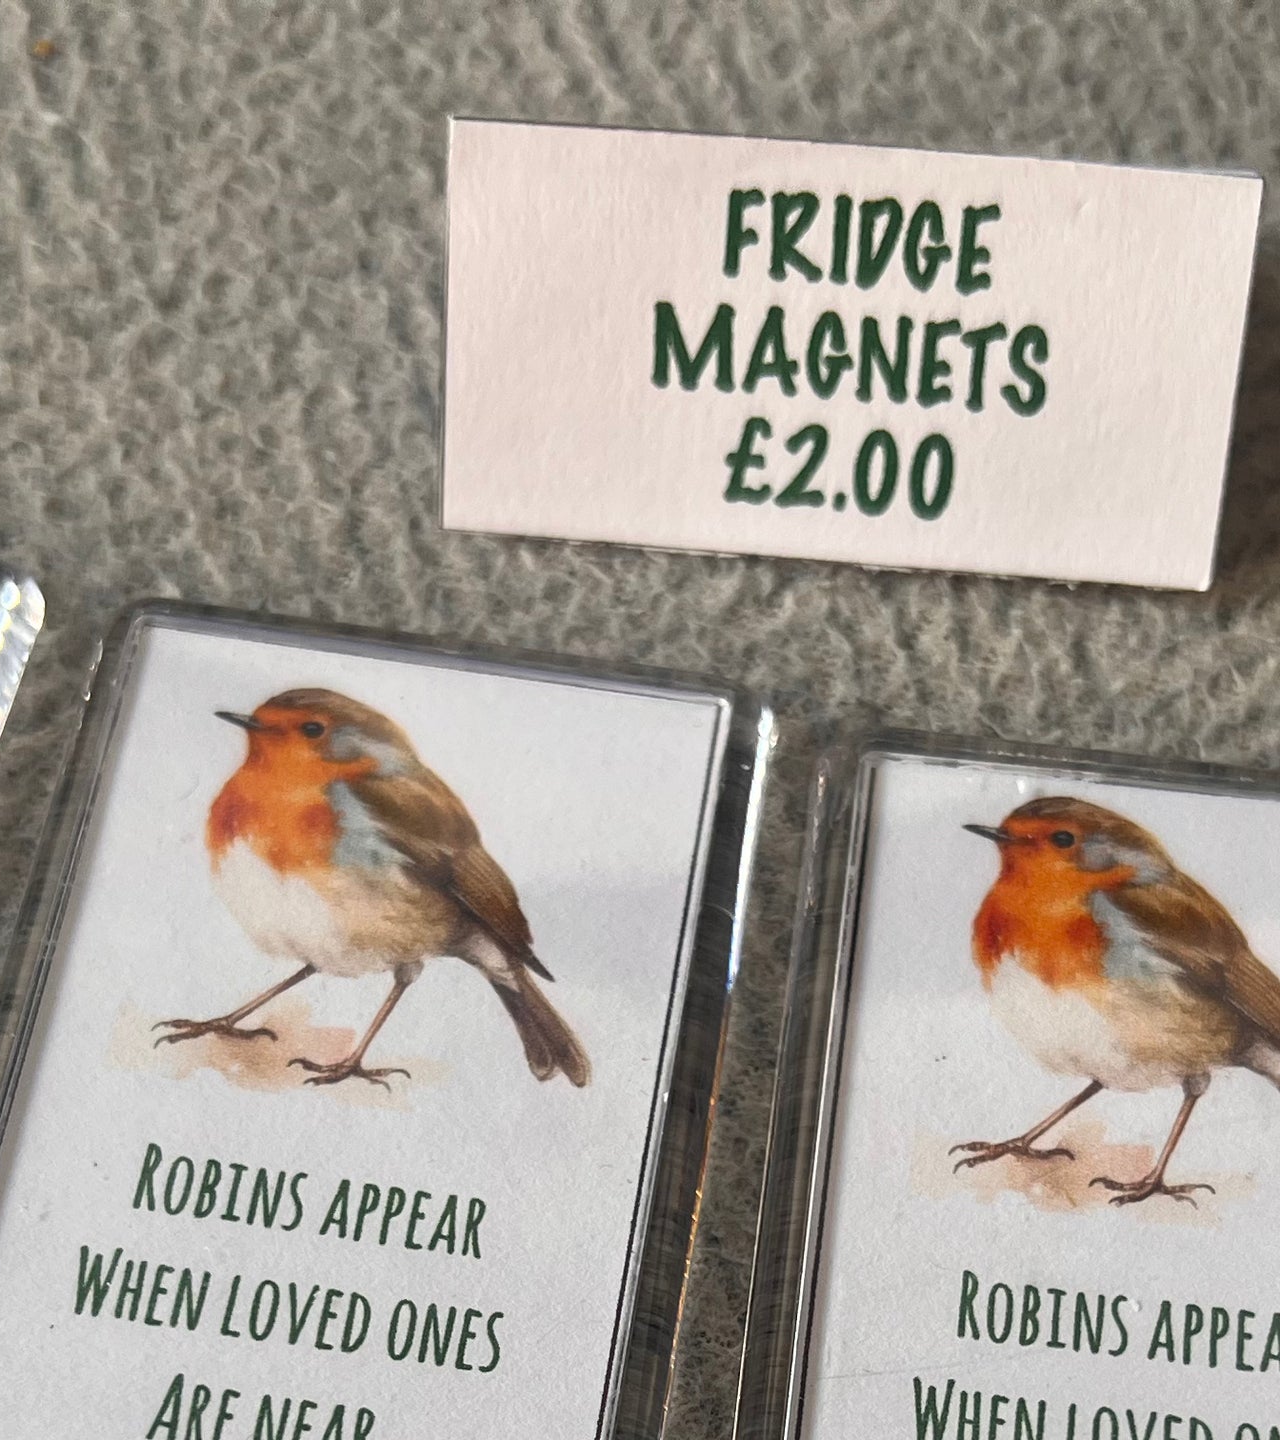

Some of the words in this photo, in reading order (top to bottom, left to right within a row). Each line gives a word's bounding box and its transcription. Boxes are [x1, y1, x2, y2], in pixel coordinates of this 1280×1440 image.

[721, 184, 1004, 298] FRIDGE
[649, 298, 1051, 419] MAGNETS
[721, 414, 957, 523] £2.00
[130, 1141, 310, 1233] ROBINS
[317, 1177, 488, 1261] APPEAR
[72, 1243, 214, 1333] WHEN
[218, 1273, 373, 1355] LOVED
[385, 1297, 506, 1375] ONES
[955, 1268, 1130, 1359] ROBINS
